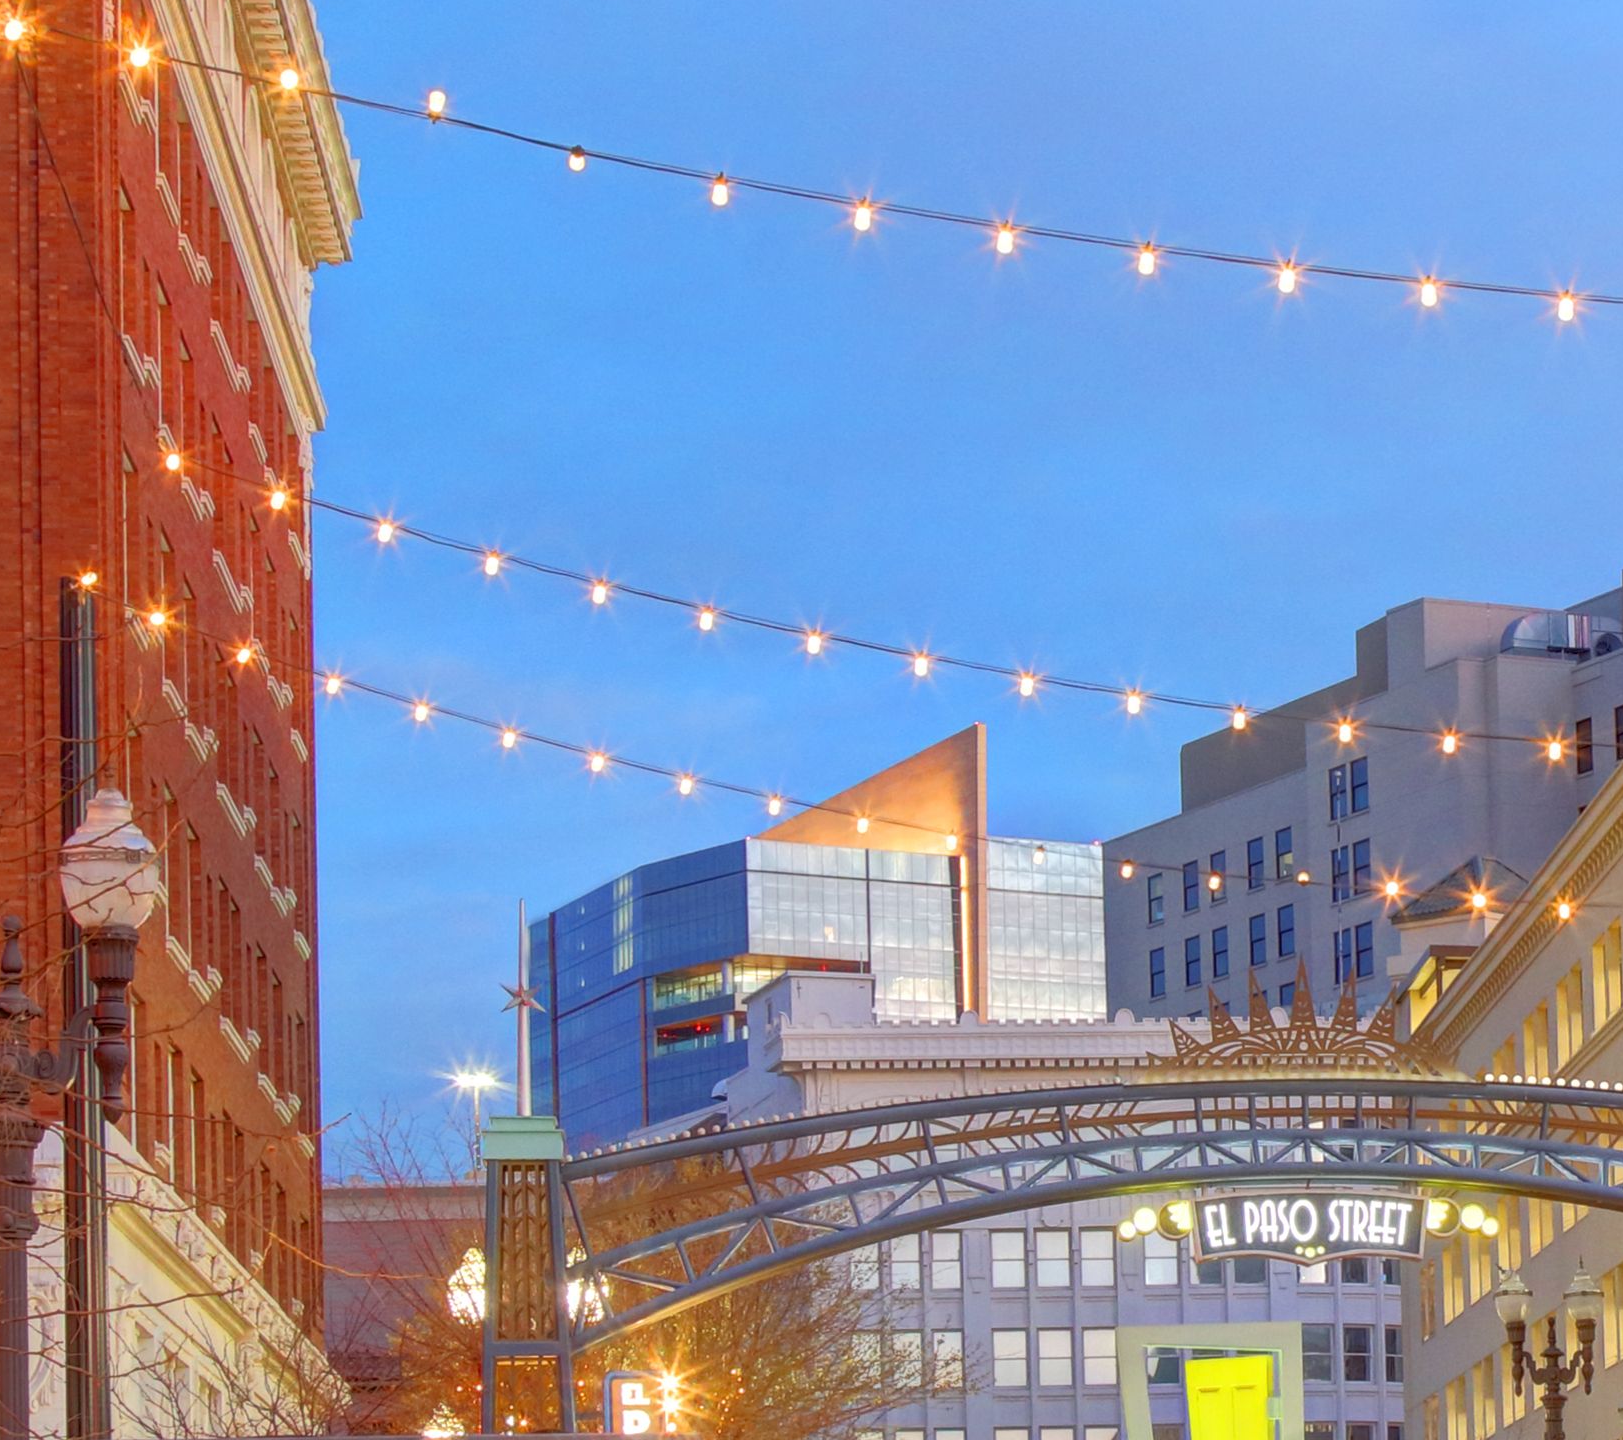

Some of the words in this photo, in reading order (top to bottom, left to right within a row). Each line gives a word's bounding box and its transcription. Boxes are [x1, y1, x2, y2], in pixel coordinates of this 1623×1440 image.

[1204, 1202, 1236, 1248] EL
[1243, 1198, 1318, 1244] PASO
[1328, 1198, 1413, 1246] STREET
